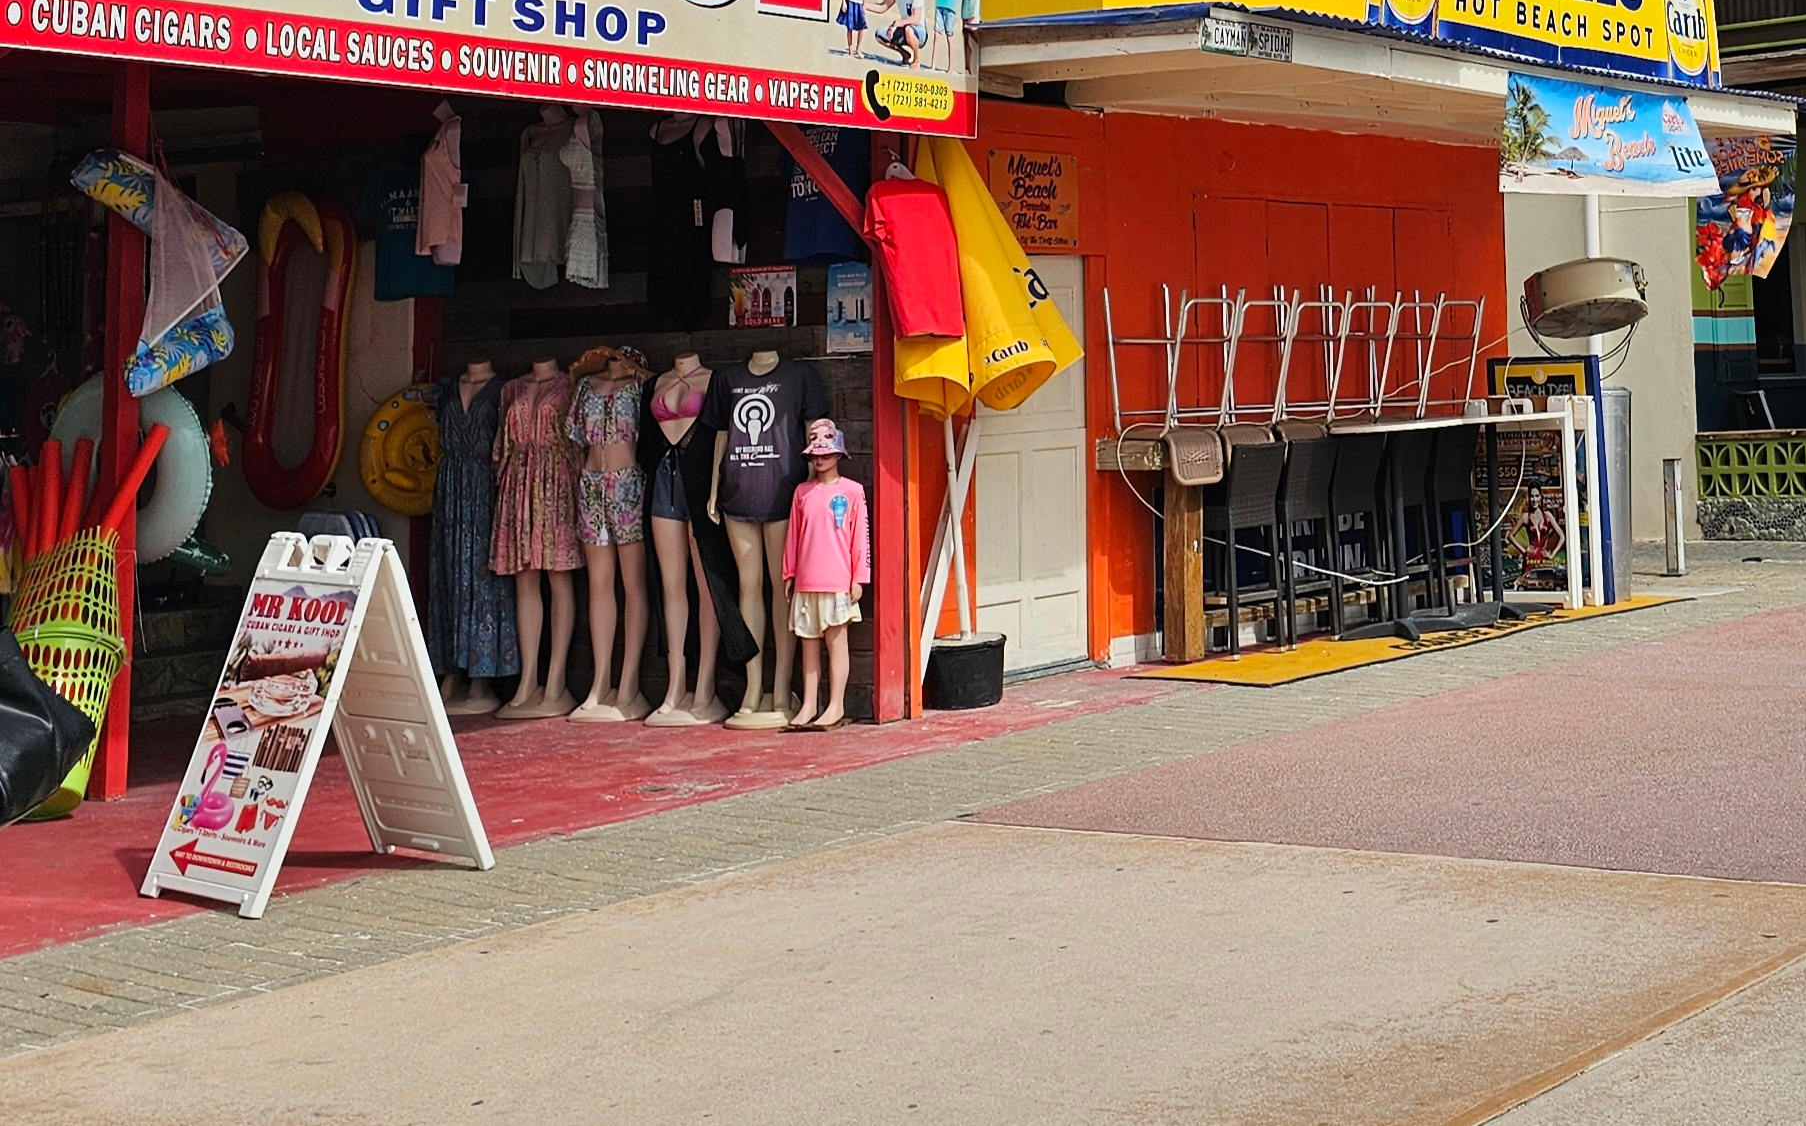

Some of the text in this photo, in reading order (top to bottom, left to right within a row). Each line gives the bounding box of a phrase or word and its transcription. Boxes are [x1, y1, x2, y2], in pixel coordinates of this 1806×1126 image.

[1516, 1, 1587, 38] BEACH
[1602, 19, 1653, 49] SPOT
[1666, 0, 1706, 41] Carib
[1214, 27, 1291, 54] CAYMAN SPIDAH
[1678, 46, 1698, 58] LAGER
[133, 7, 232, 51] CIGARS
[265, 21, 341, 64] LOCAL
[345, 32, 434, 72] SAUCES
[457, 42, 561, 87] SOUVENIR
[583, 62, 699, 100] SNORKELING
[704, 73, 750, 105] GEAR
[767, 77, 819, 111] VAPES
[823, 84, 854, 114] PEN
[881, 80, 890, 90] +1
[893, 80, 912, 93] (721)
[880, 94, 948, 110] +1 (721) 581-4213
[1603, 129, 1656, 172] Beach
[1669, 145, 1706, 173] Lite
[1008, 153, 1062, 181] Miguel's
[1008, 176, 1057, 200] Beach
[1033, 213, 1058, 231] Bar
[991, 340, 1029, 363] Carib
[1498, 466, 1517, 478] $50
[248, 592, 349, 626] MR KOOL
[246, 620, 270, 631] CUBAN
[271, 621, 296, 634] CIGARS
[303, 626, 320, 636] GIFT
[321, 628, 341, 638] SHOP
